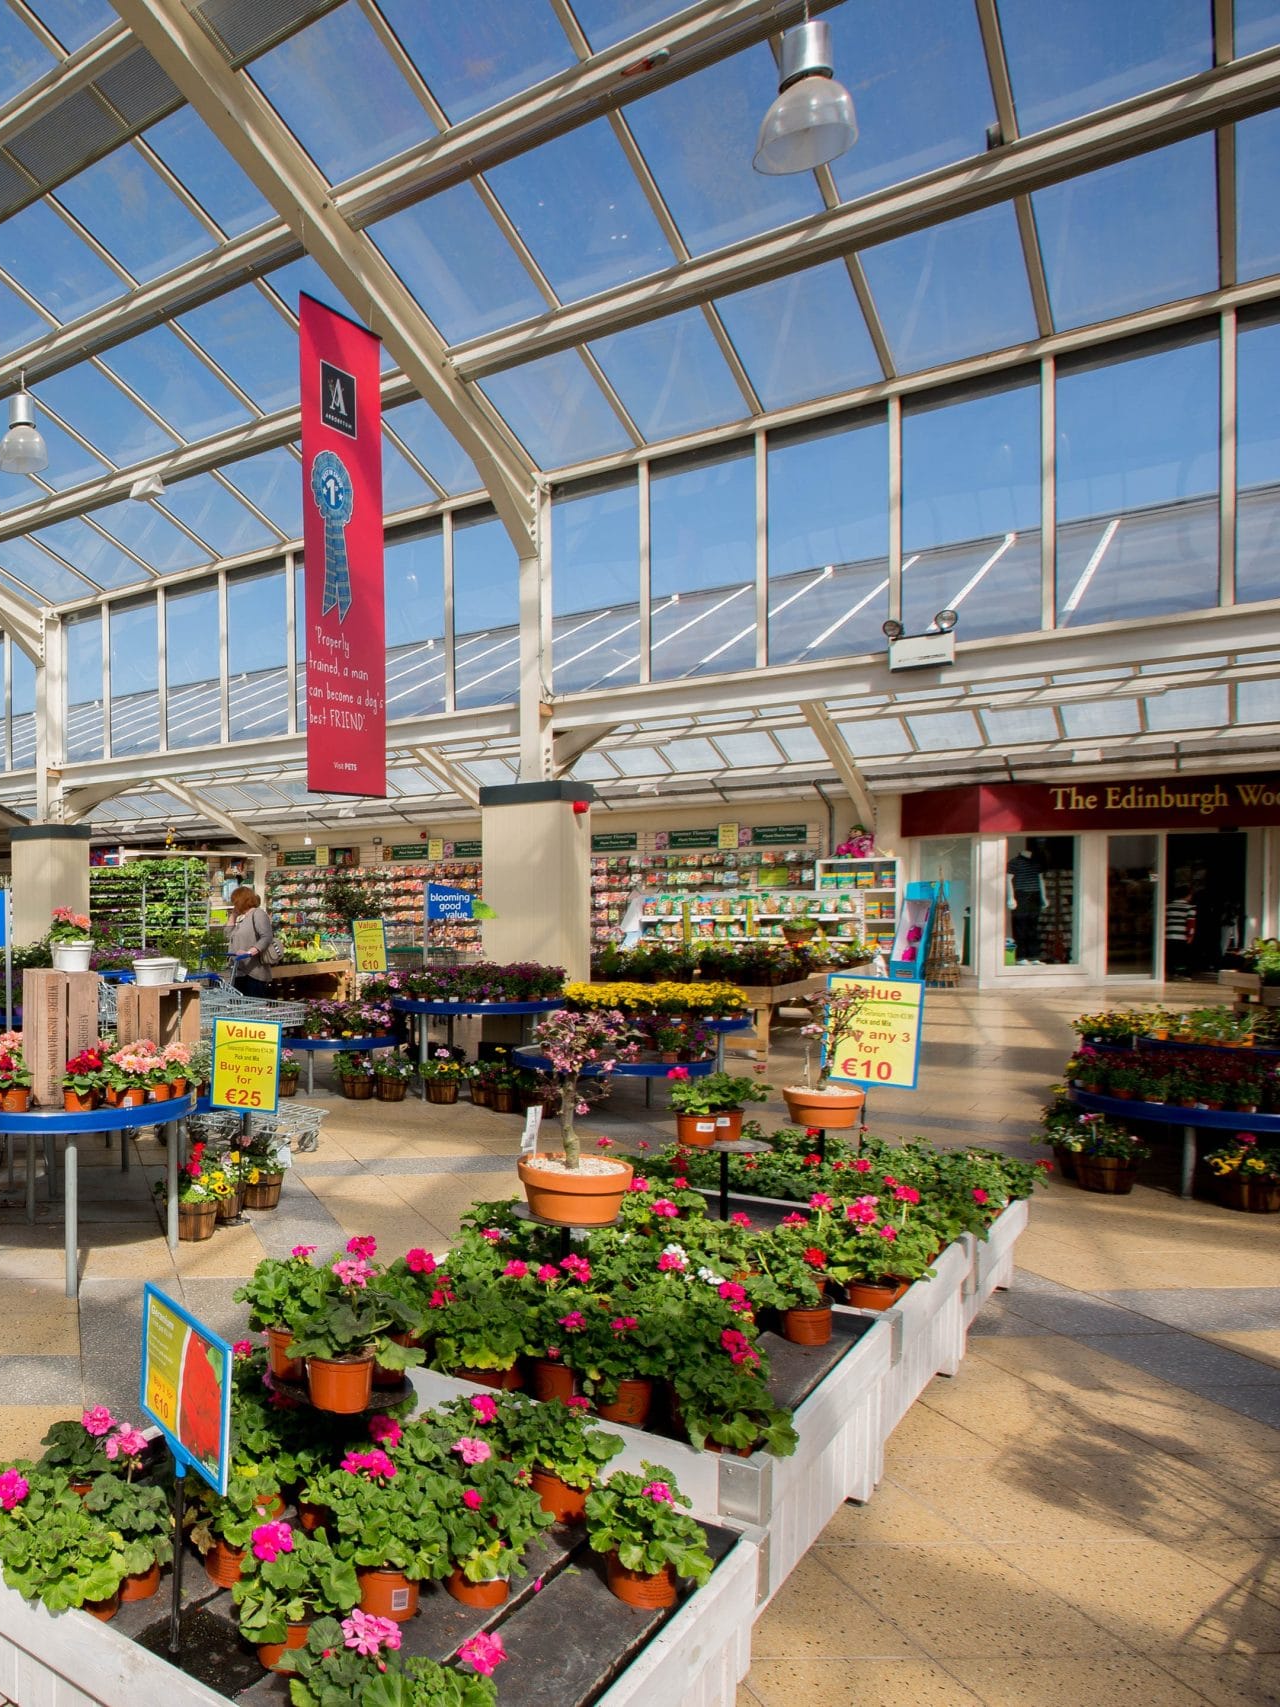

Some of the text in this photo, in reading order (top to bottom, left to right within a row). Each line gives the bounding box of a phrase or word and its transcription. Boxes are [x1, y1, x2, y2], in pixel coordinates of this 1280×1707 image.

[329, 378, 348, 416] A
[309, 650, 369, 681] trained, a man
[308, 682, 384, 715] can become a dog's
[309, 705, 326, 725] best
[344, 763, 358, 771] PETS
[1049, 787, 1098, 810] The
[1104, 784, 1229, 815] Edinburgh
[430, 893, 470, 903] blooming
[439, 902, 461, 912] good
[445, 910, 468, 919] value
[358, 921, 377, 929] Value
[362, 960, 379, 970] €10
[845, 983, 902, 1001] Vlue
[78, 1014, 89, 1053] ARBORET
[226, 1025, 266, 1039] Value
[869, 1031, 897, 1043] any
[902, 1032, 911, 1043] 3
[858, 1042, 880, 1054] for
[220, 1061, 273, 1076] Buy any 2
[841, 1057, 892, 1080] €10
[237, 1075, 252, 1085] for
[225, 1088, 261, 1107] €25
[154, 1393, 169, 1419] €10
